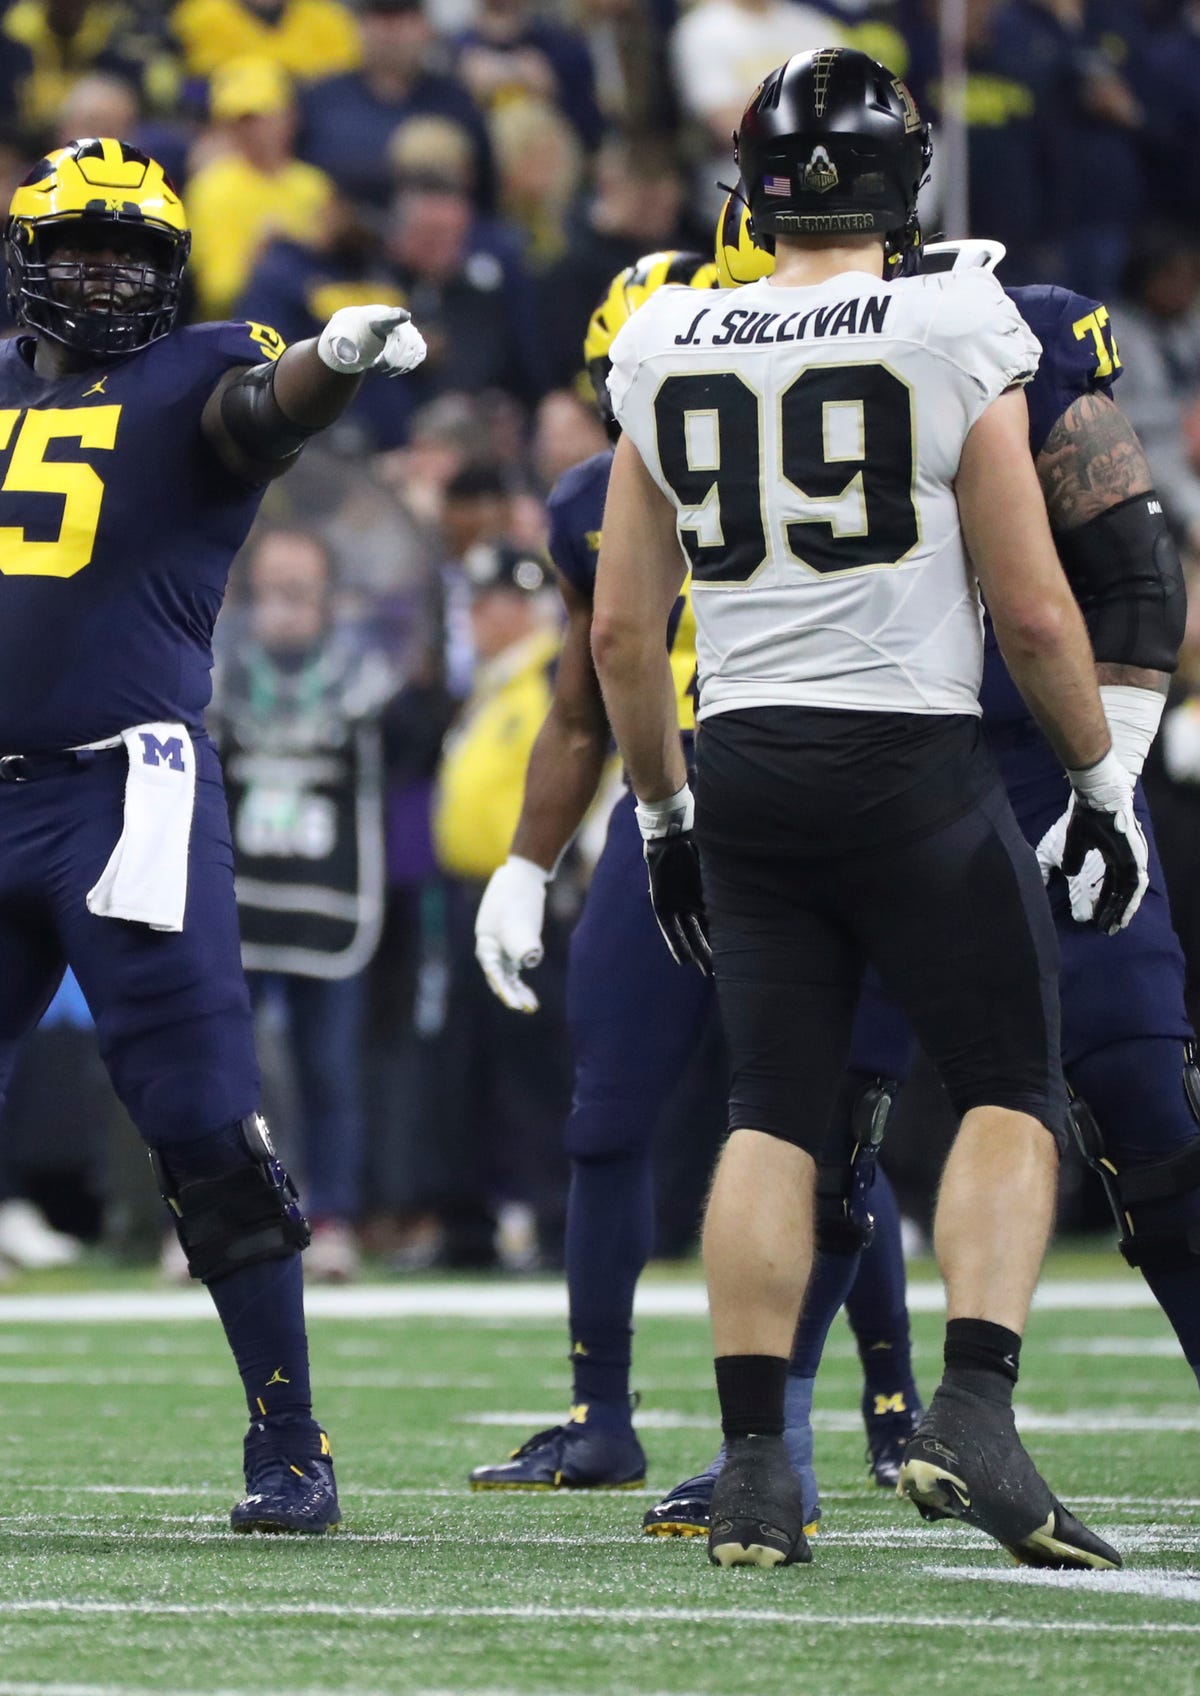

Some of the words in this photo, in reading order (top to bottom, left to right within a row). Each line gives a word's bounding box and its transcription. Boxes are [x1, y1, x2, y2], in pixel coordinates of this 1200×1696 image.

[675, 308, 710, 345] J.
[712, 295, 892, 345] SULLIVAN
[653, 359, 924, 587] 99
[138, 732, 185, 773] M
[873, 1392, 906, 1415] M
